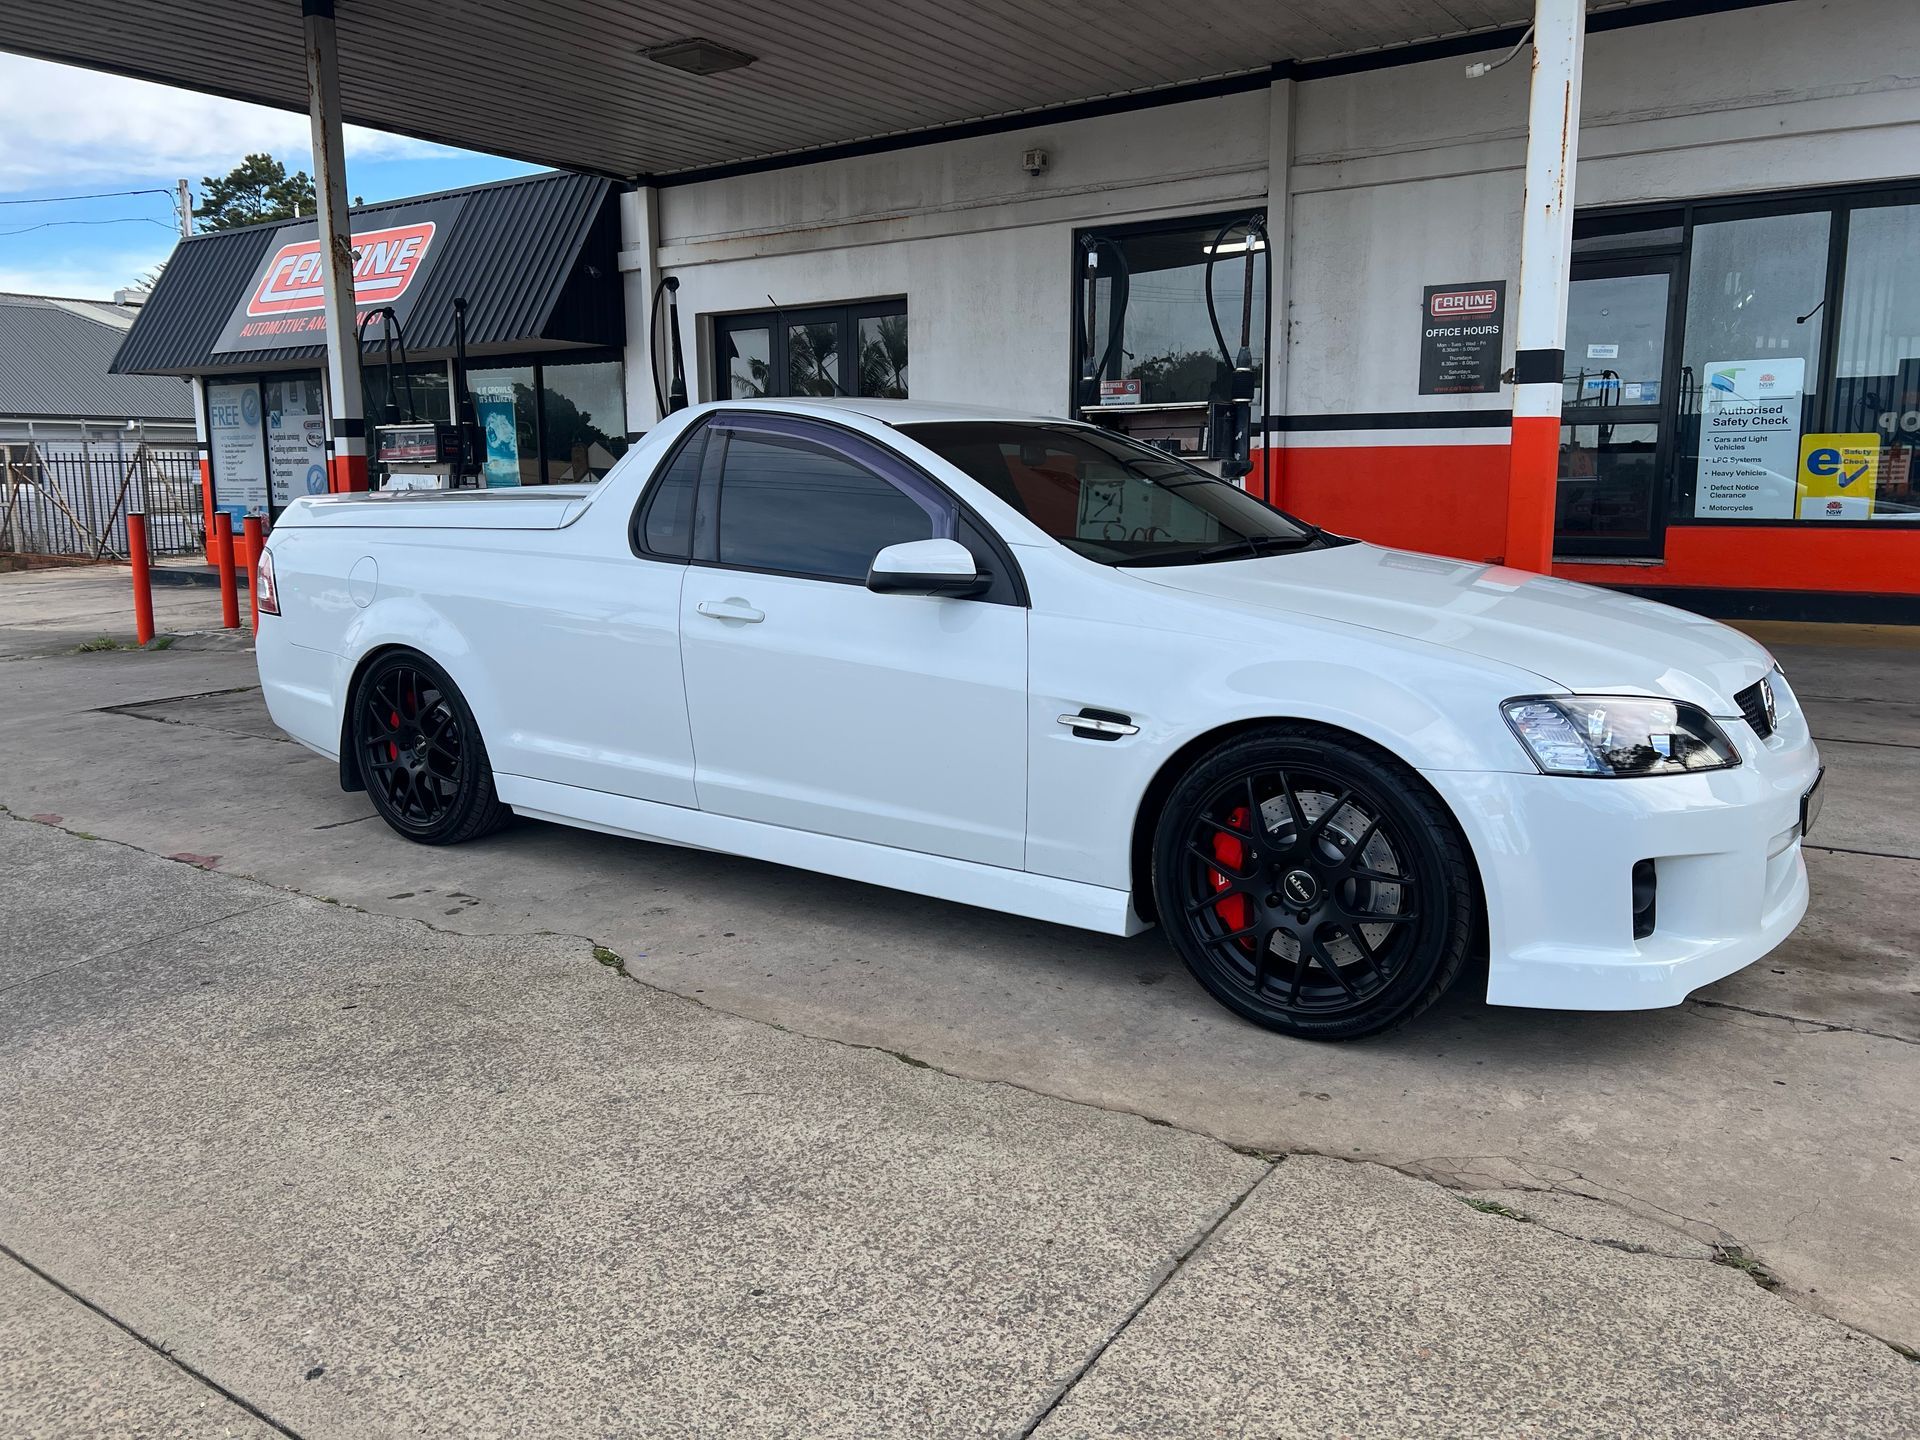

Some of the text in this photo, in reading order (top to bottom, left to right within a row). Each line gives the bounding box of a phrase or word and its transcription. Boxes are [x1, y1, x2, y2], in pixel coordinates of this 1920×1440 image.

[259, 236, 424, 303] CAINE
[1434, 294, 1493, 312] CARLINE
[240, 316, 306, 337] AUTOMOTIVE
[1425, 325, 1500, 338] OFFICE HOURS
[211, 405, 239, 427] FREE
[1719, 405, 1783, 415] Authorised
[1712, 416, 1789, 428] Safety Check
[1748, 435, 1768, 443] Light
[1844, 448, 1872, 456] Safety
[1730, 456, 1762, 464] Systems
[1807, 448, 1842, 476] e
[1708, 504, 1754, 512] Motorcycles
